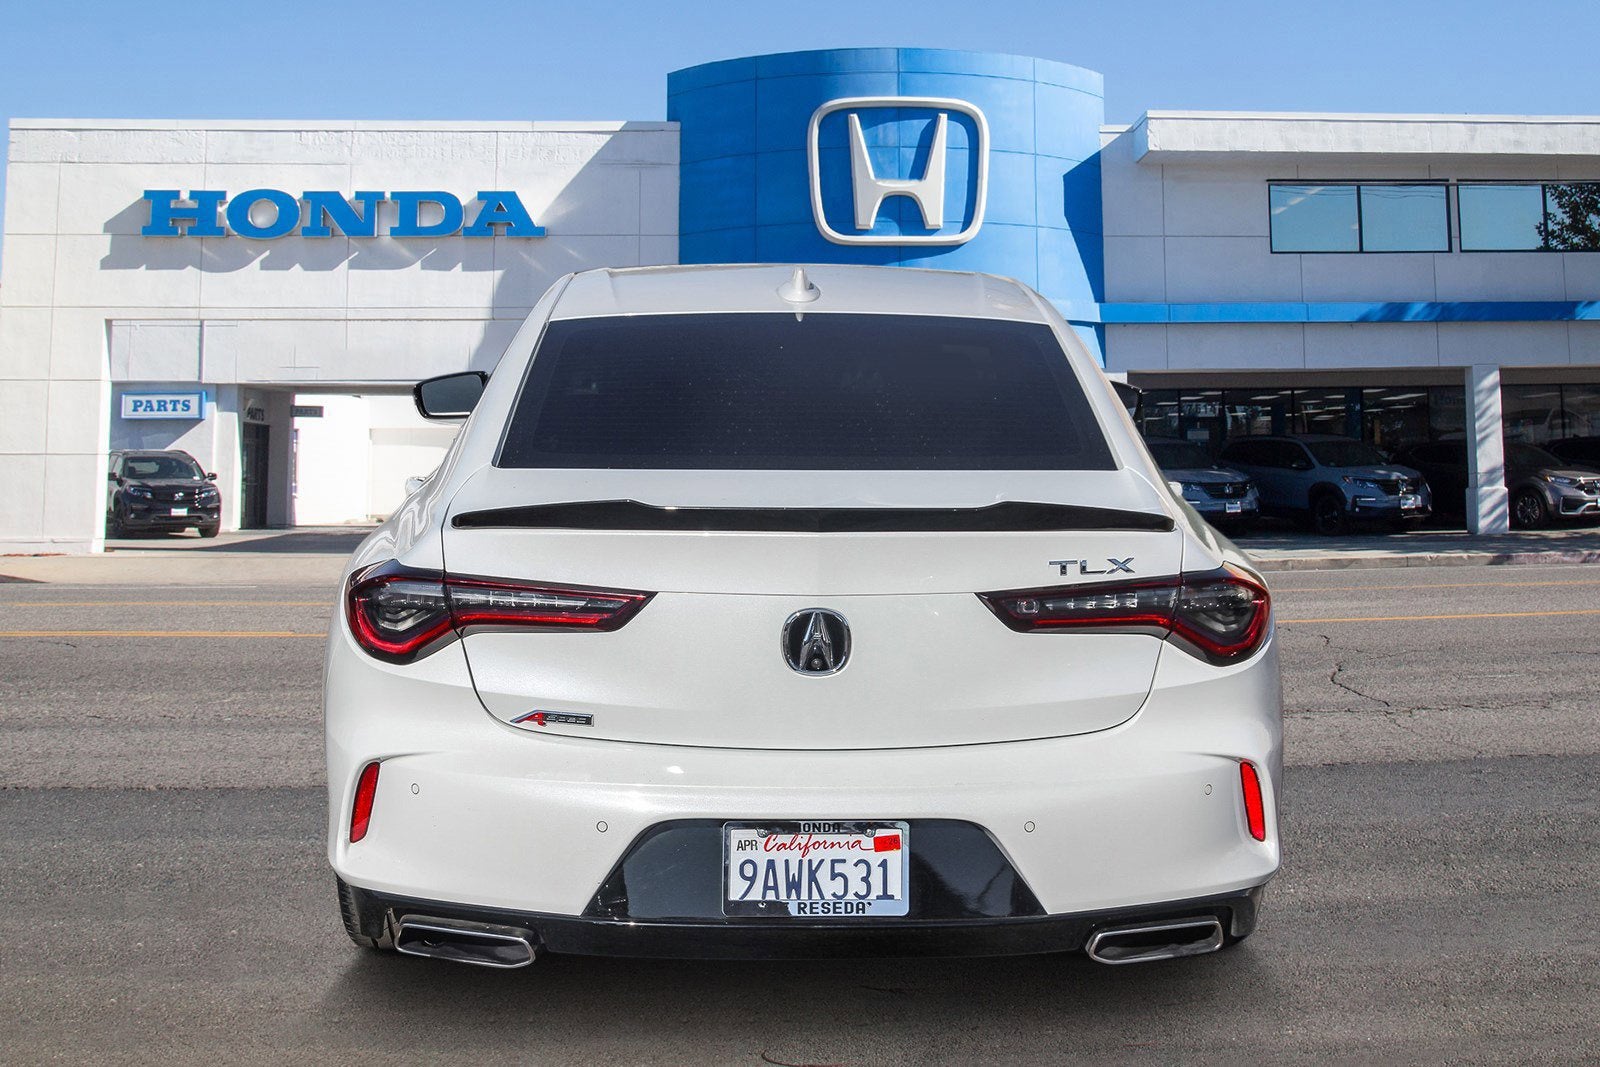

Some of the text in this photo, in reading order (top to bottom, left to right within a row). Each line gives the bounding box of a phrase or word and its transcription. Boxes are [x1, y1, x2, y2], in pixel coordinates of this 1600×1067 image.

[141, 189, 548, 239] HONDA
[131, 399, 192, 413] PARTS
[1048, 557, 1136, 577] TLX
[736, 833, 873, 858] APR California
[738, 859, 896, 900] 9AWK531
[797, 902, 867, 915] RESEDA
